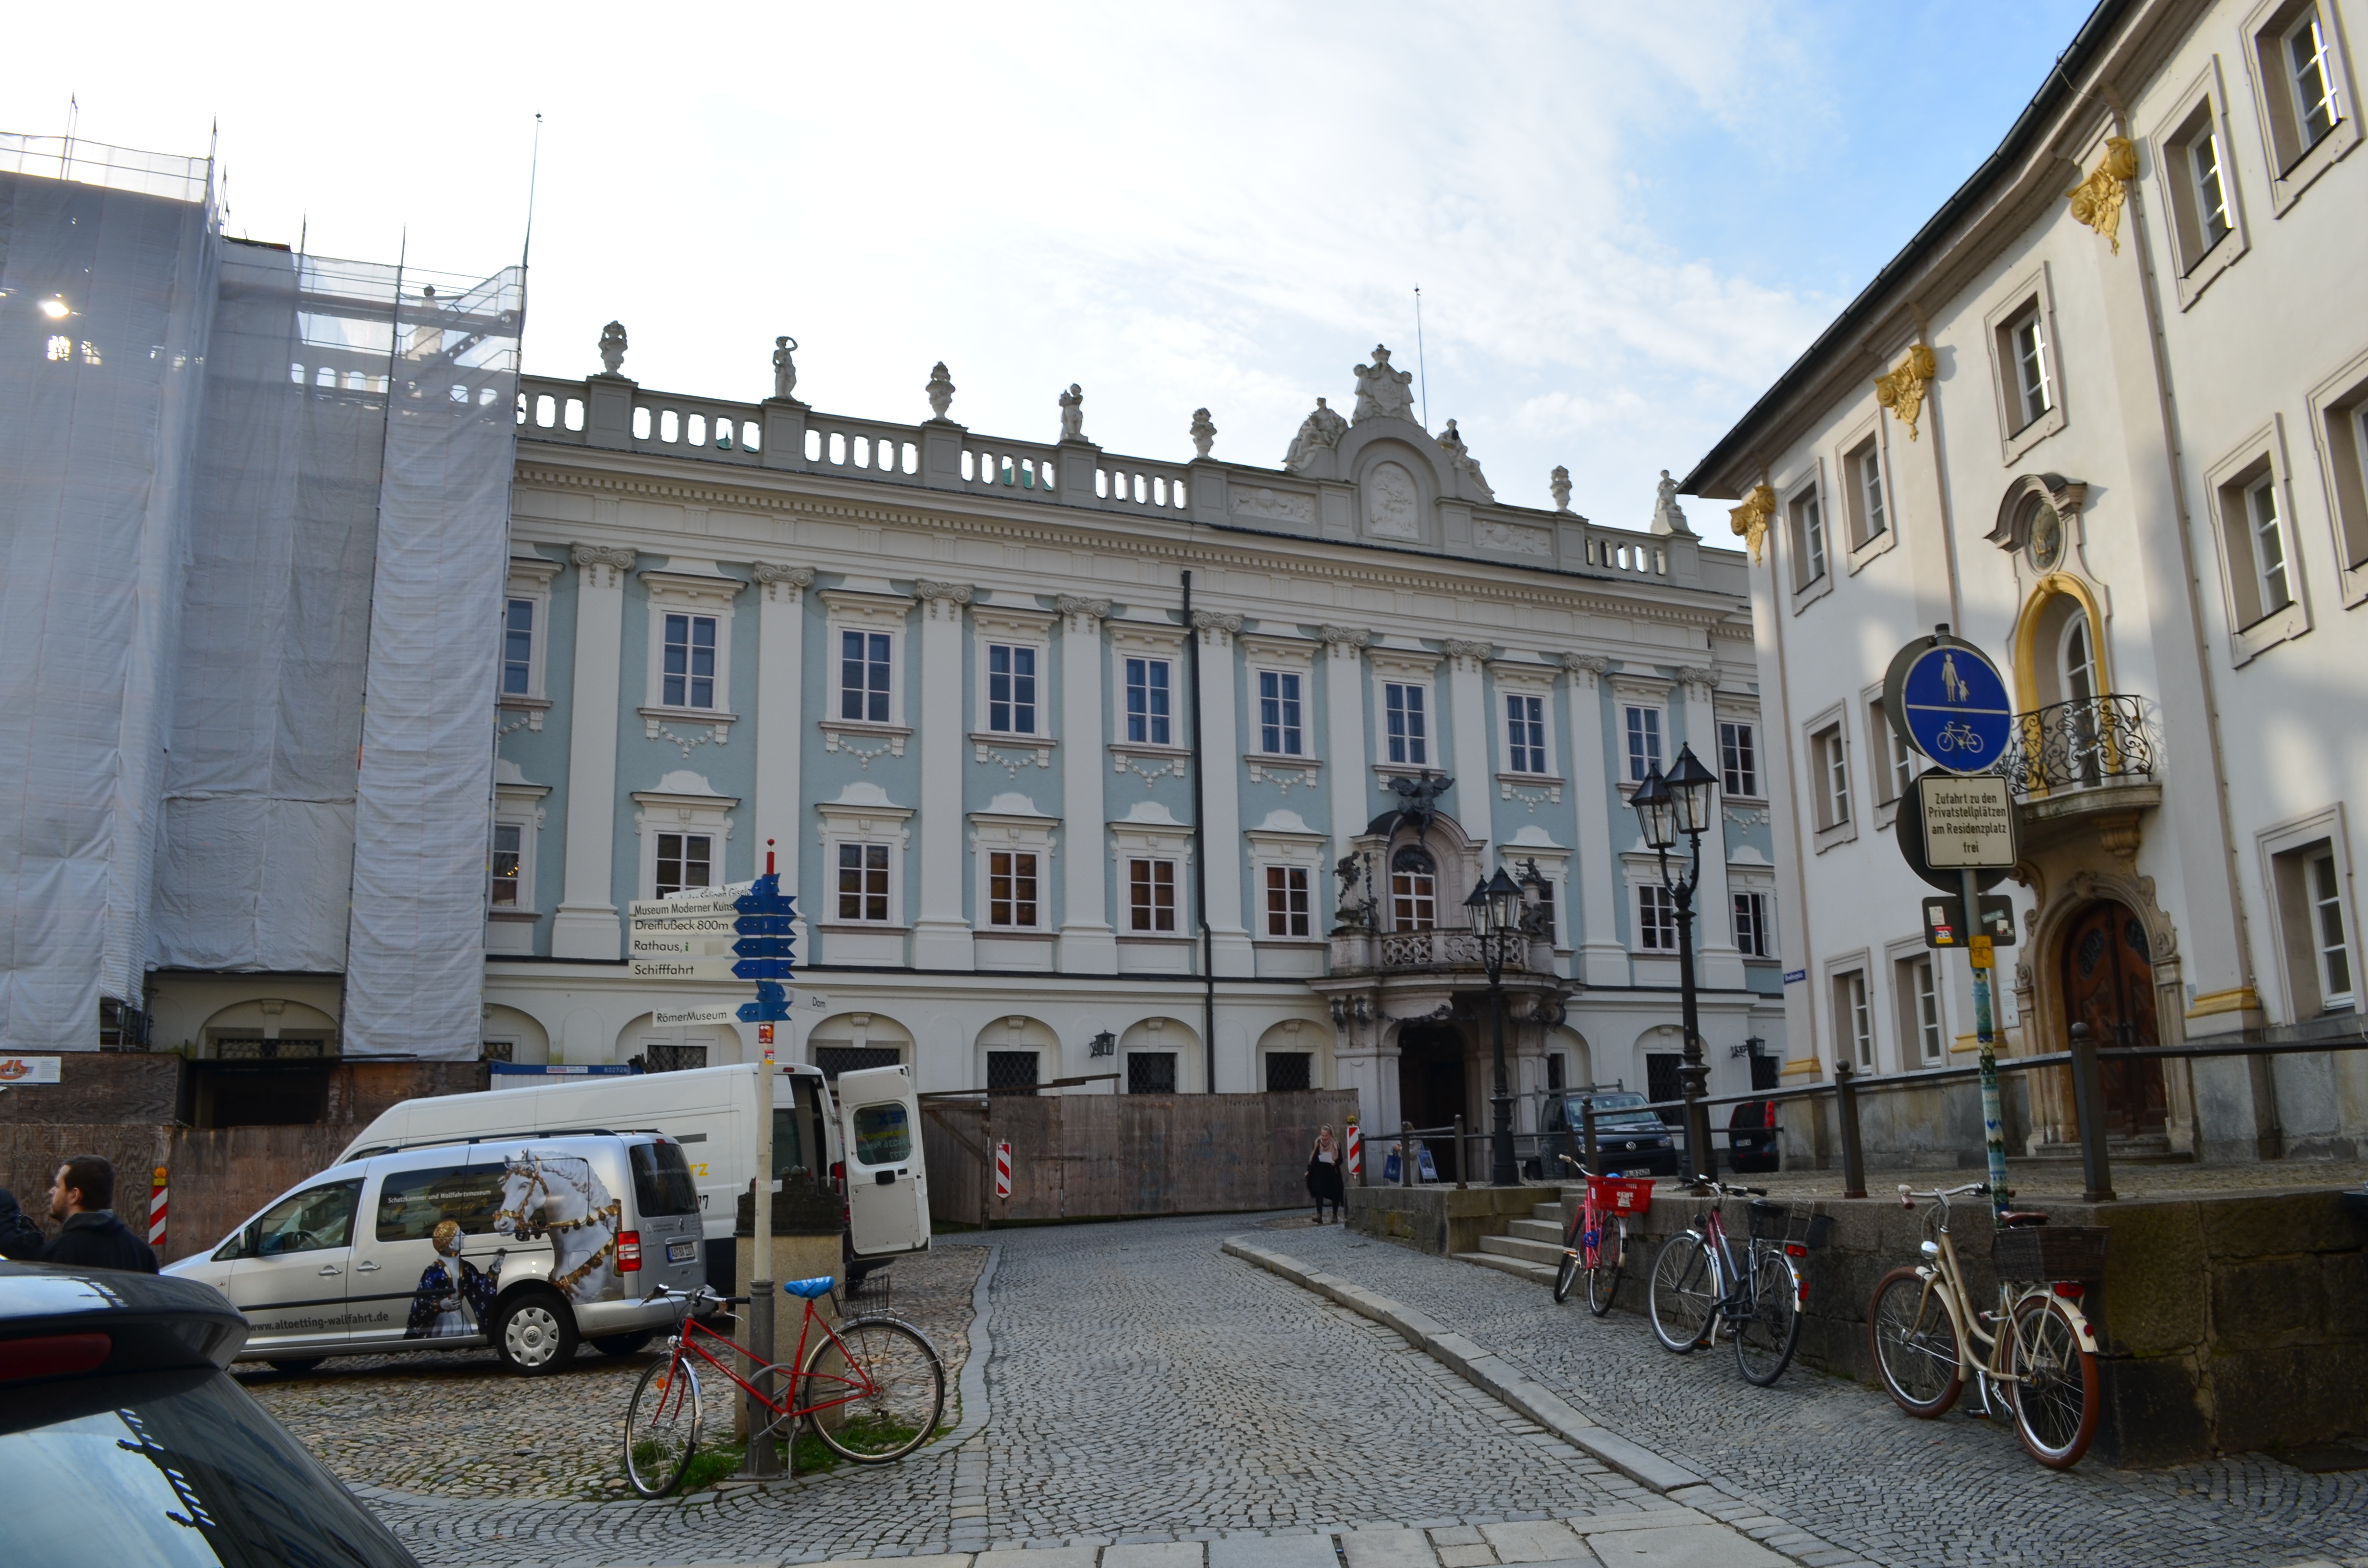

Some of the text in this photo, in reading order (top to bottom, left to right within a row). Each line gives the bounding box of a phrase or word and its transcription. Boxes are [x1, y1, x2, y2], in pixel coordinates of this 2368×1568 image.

[1935, 793, 1997, 805] Zufahrt zu den
[1928, 806, 2006, 821] Privatstellplätzen
[1932, 822, 2007, 837] am Residenzplatz
[1963, 841, 1979, 853] frei
[635, 901, 736, 916] Museum Moderner Kuns
[635, 919, 728, 931] Dreiflußeck 800m
[634, 940, 689, 953] Rathaus, i
[635, 965, 694, 975] Schifffahrt
[813, 996, 826, 1008] Dom
[657, 1011, 727, 1023] RömerMuseum
[441, 1189, 491, 1199] Wallfahrtsmuseum
[250, 1311, 389, 1332] www.altoetting-wallfahrt.de
